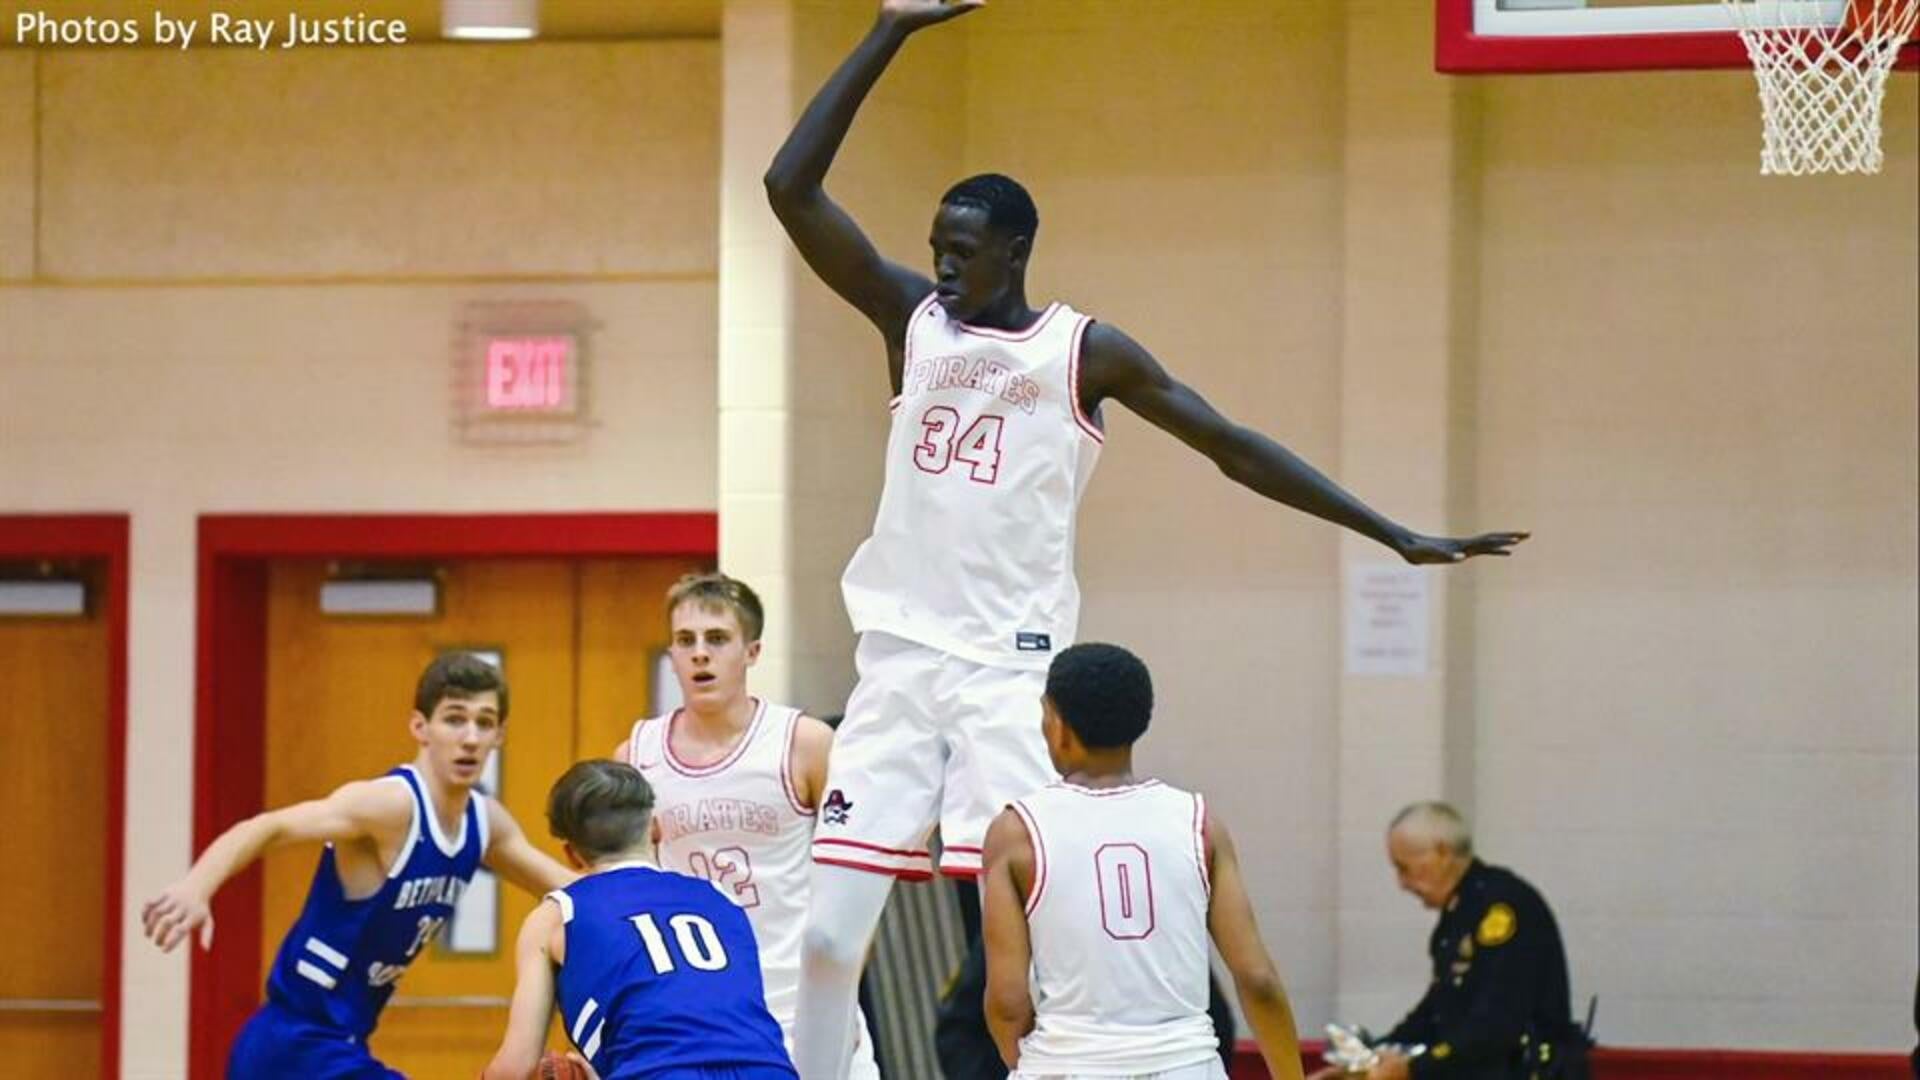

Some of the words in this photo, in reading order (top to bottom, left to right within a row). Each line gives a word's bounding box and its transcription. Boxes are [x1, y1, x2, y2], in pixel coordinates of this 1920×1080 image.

[487, 340, 567, 407] EXIT
[908, 356, 1040, 415] PIRATES
[913, 405, 1004, 484] 34
[1094, 843, 1155, 940] 0
[628, 912, 729, 975] 10
